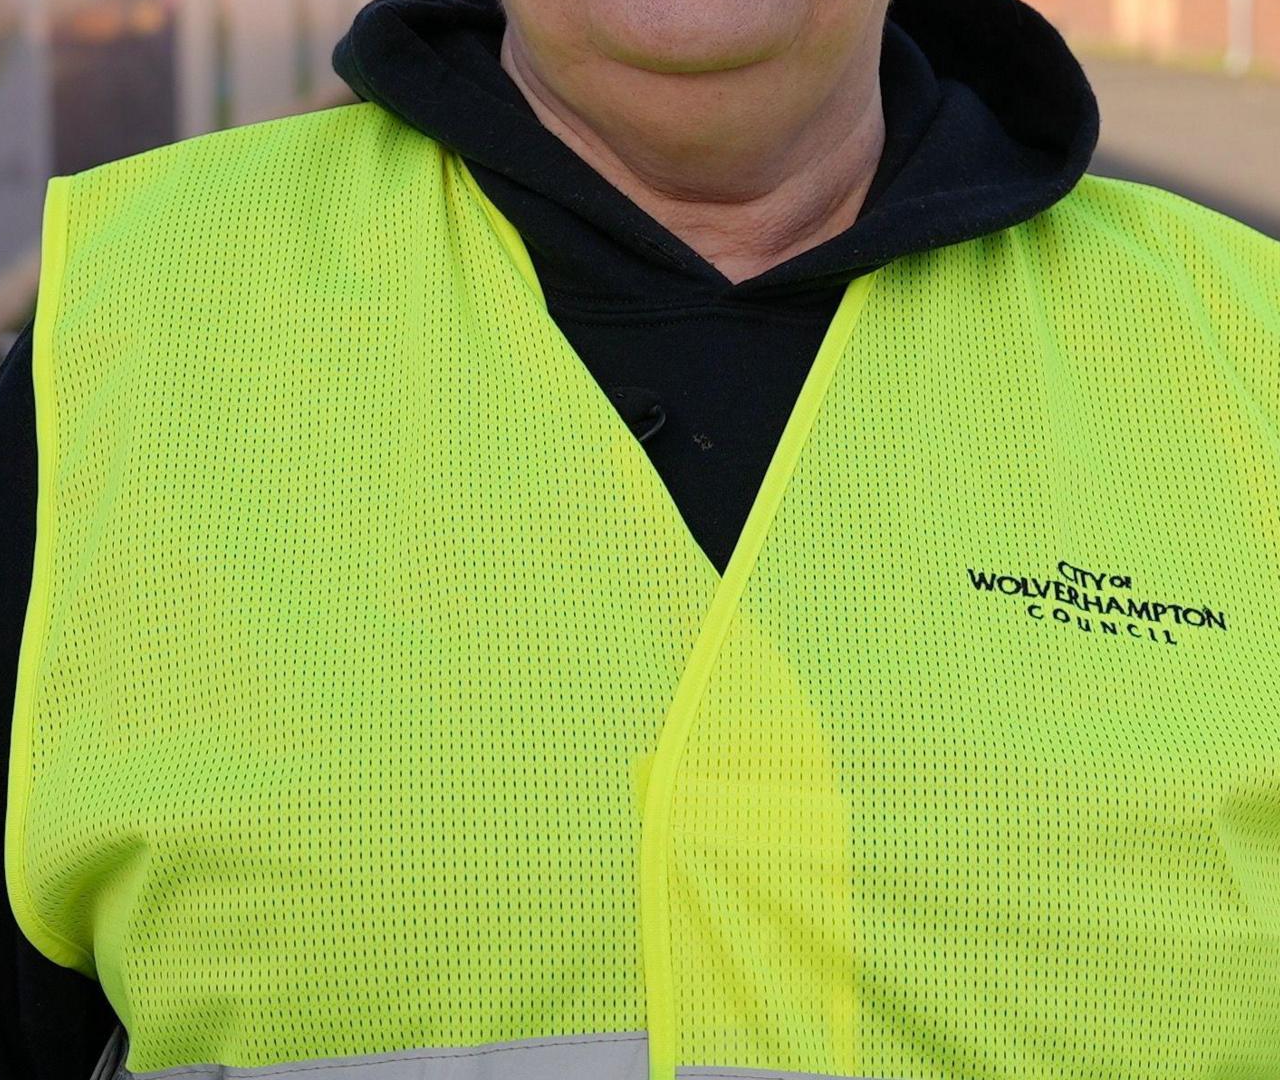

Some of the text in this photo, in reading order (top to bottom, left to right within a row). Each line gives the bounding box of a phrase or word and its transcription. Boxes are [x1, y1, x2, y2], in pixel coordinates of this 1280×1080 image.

[1056, 560, 1132, 591] CITY OF
[966, 568, 1228, 631] WOLVERHAMPTON
[1027, 604, 1178, 645] COUNCIL
